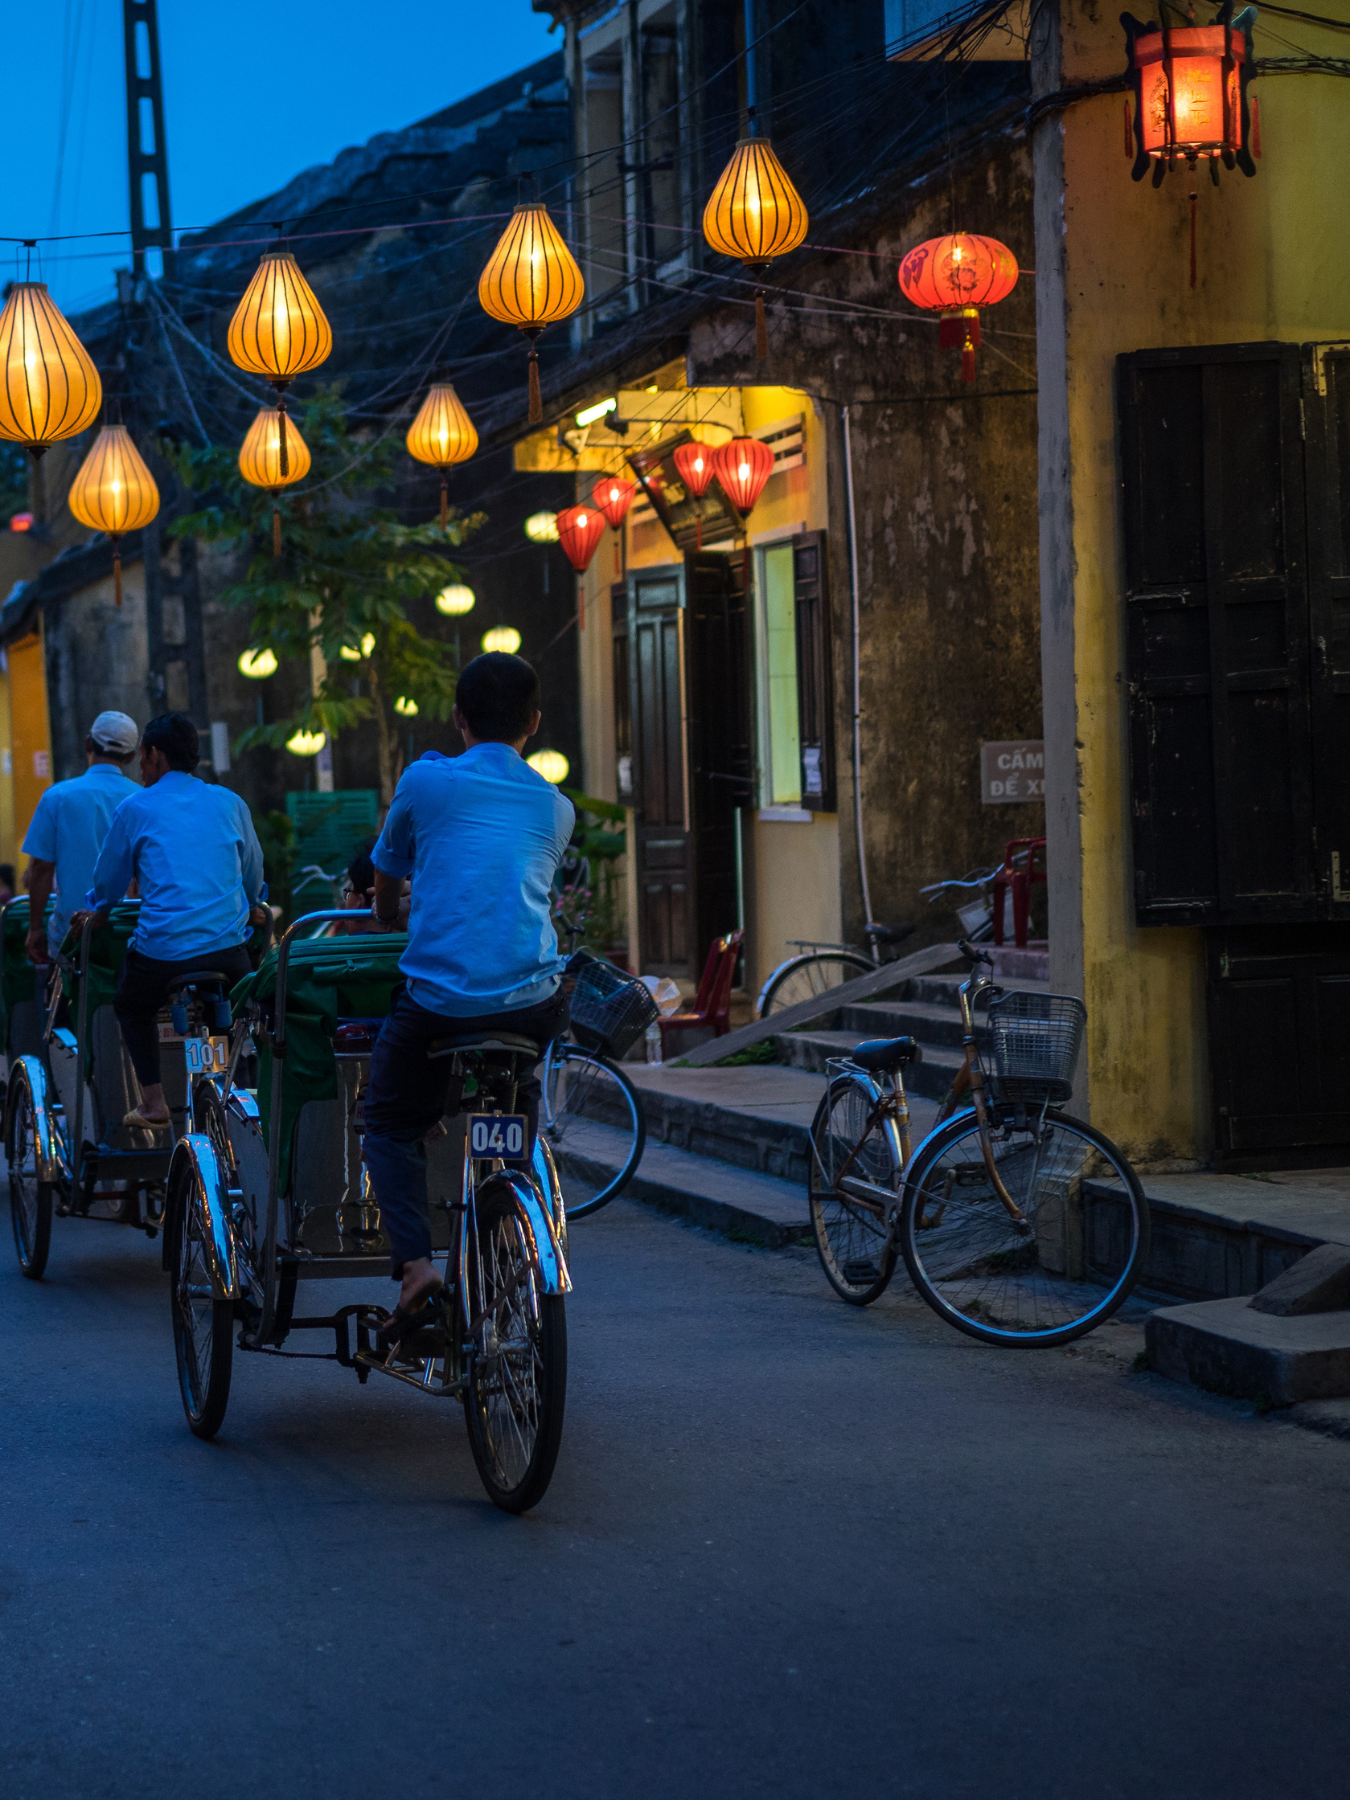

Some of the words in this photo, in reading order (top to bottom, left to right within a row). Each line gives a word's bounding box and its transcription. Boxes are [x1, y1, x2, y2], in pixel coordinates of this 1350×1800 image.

[997, 747, 1044, 769] CẤM
[187, 1042, 225, 1066] 101
[472, 1122, 522, 1152] 040
